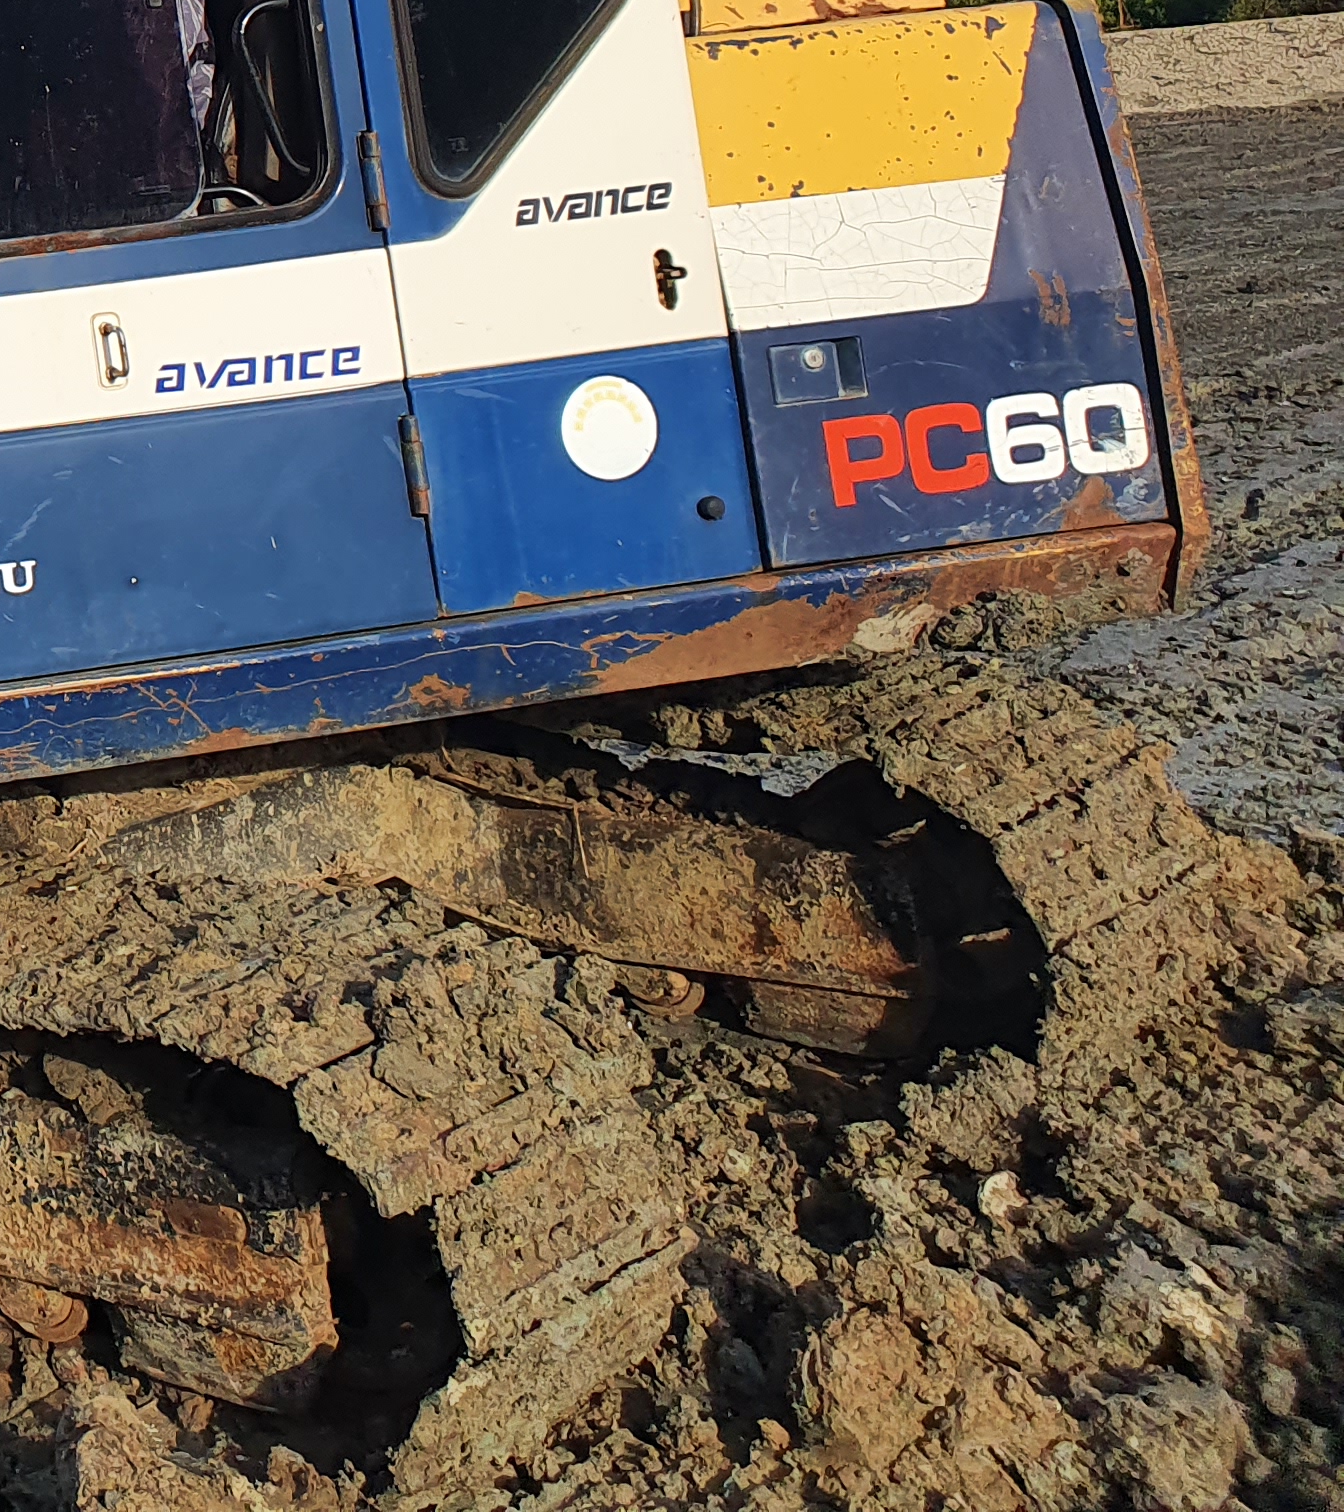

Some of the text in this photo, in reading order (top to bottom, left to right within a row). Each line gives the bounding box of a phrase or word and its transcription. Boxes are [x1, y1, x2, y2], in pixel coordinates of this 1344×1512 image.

[515, 182, 673, 227] avance
[154, 345, 362, 394] avance
[822, 382, 1150, 508] PC60
